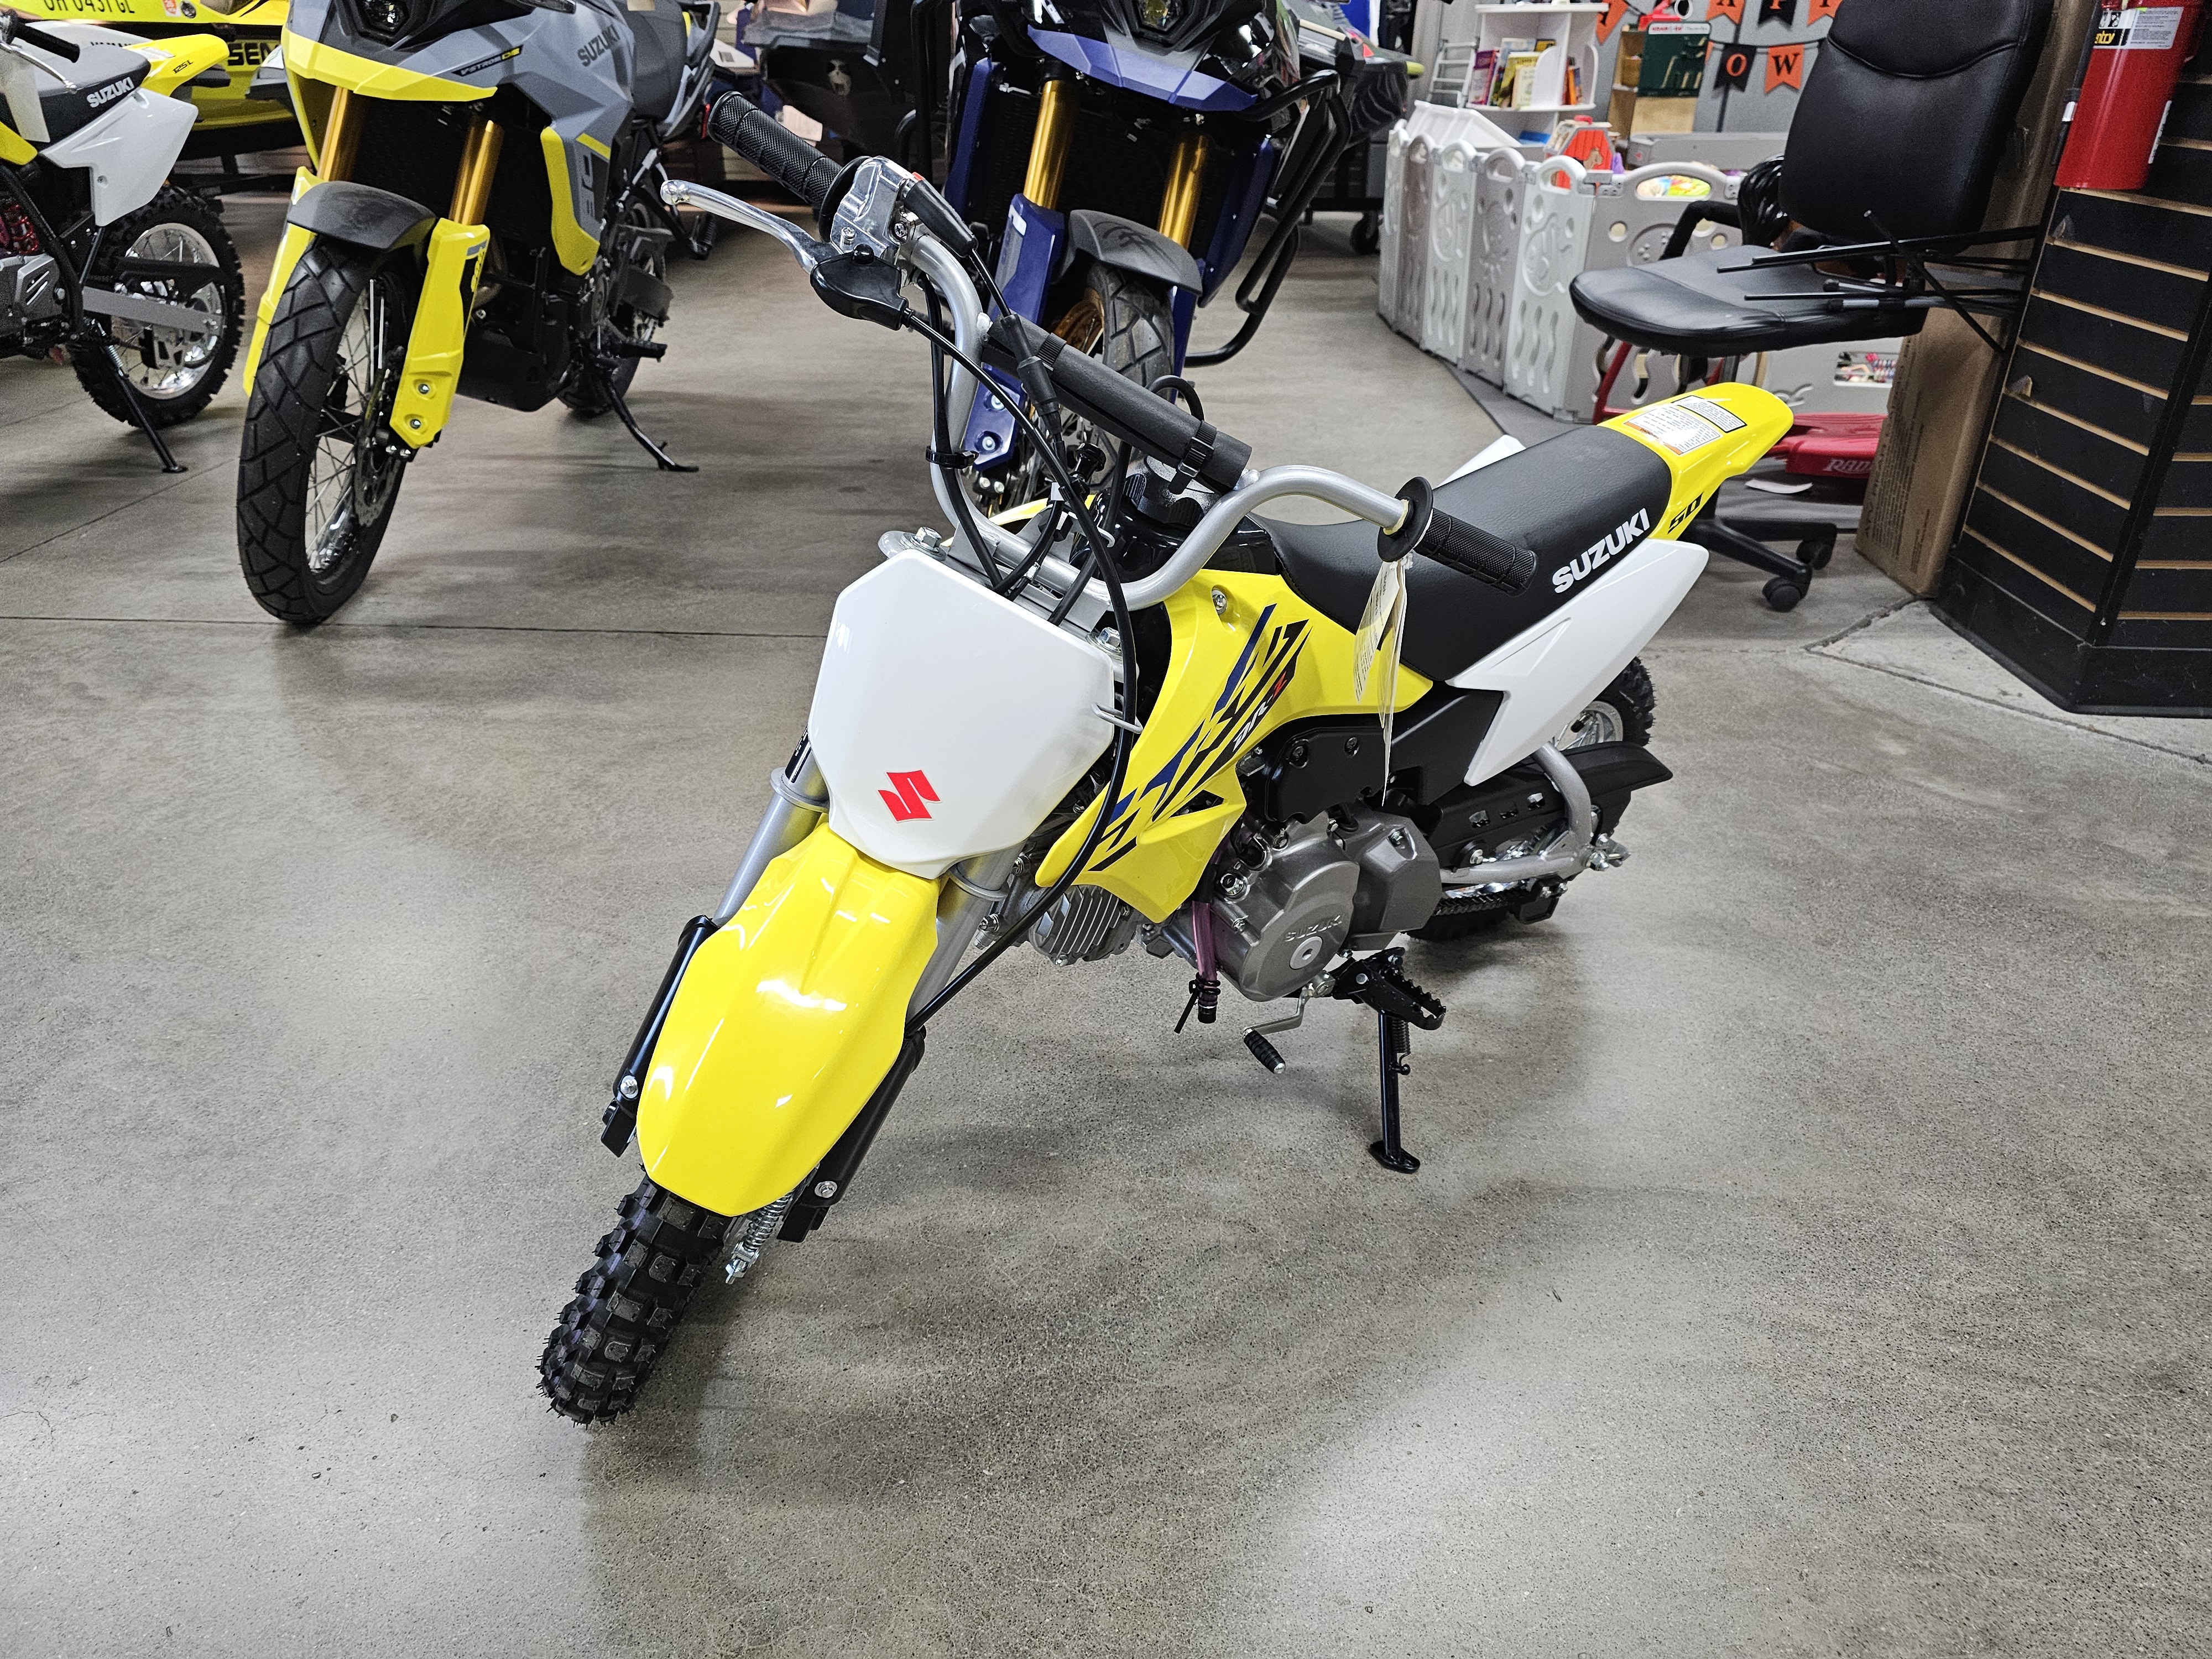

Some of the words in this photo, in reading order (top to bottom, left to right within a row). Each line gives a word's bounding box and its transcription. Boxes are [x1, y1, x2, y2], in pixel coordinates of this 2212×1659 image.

[577, 24, 620, 67] SUZUKI
[2094, 30, 2115, 44] ntry
[87, 77, 135, 108] SUZUKI
[1667, 491, 1704, 535] 50
[1552, 508, 1650, 593] SUZUKI
[1285, 915, 1342, 942] SUZUKI
